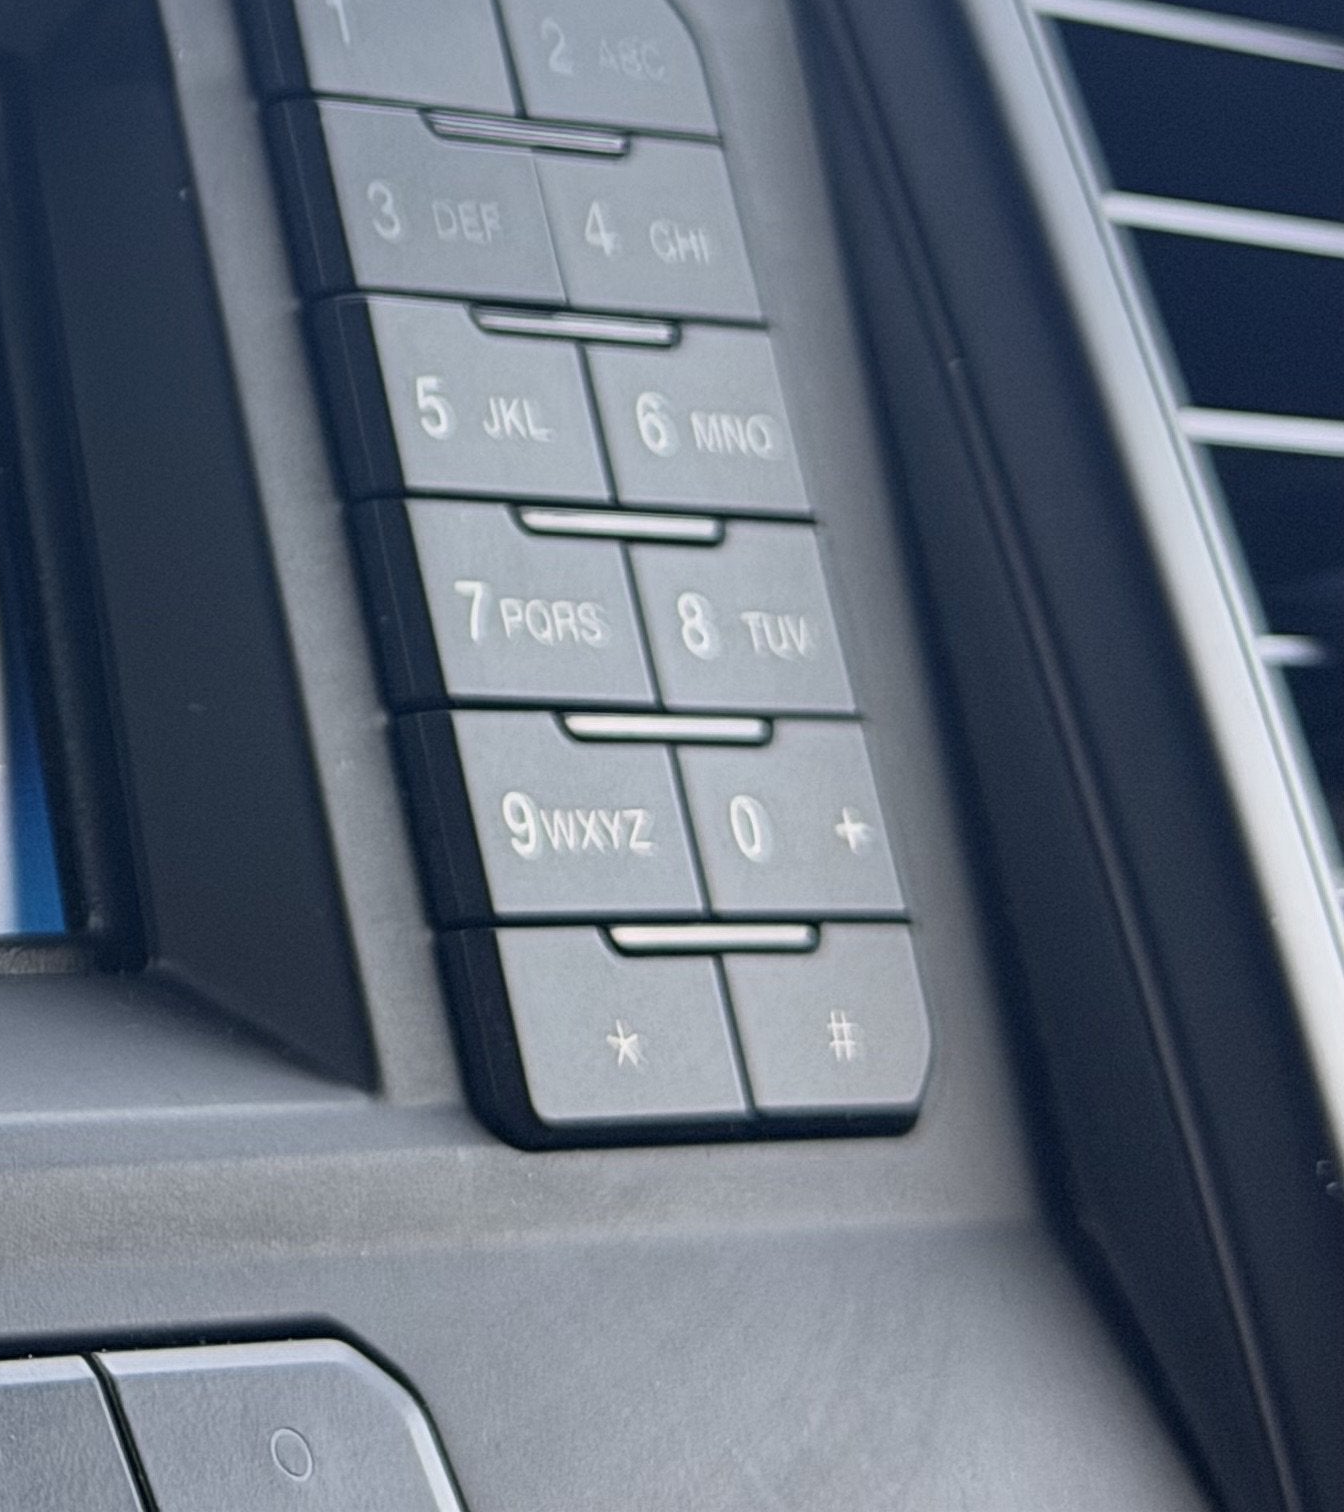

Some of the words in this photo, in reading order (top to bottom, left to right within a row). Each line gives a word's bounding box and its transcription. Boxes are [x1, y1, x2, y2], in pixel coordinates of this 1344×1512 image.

[540, 17, 574, 76] 2
[596, 41, 666, 81] ABC
[366, 180, 403, 240] 3
[431, 198, 504, 243] DEF
[584, 201, 617, 257] 4
[649, 219, 711, 265] GHI
[415, 376, 453, 439] 5
[482, 397, 553, 442] JKL
[635, 392, 675, 456] 6
[690, 410, 776, 458] MNO
[454, 581, 488, 641] 7
[500, 597, 605, 645] PQRS
[677, 592, 718, 658] 8
[741, 611, 814, 658] TUV
[502, 791, 538, 859] 9
[540, 807, 654, 852] WXYZ
[729, 794, 768, 862] 0
